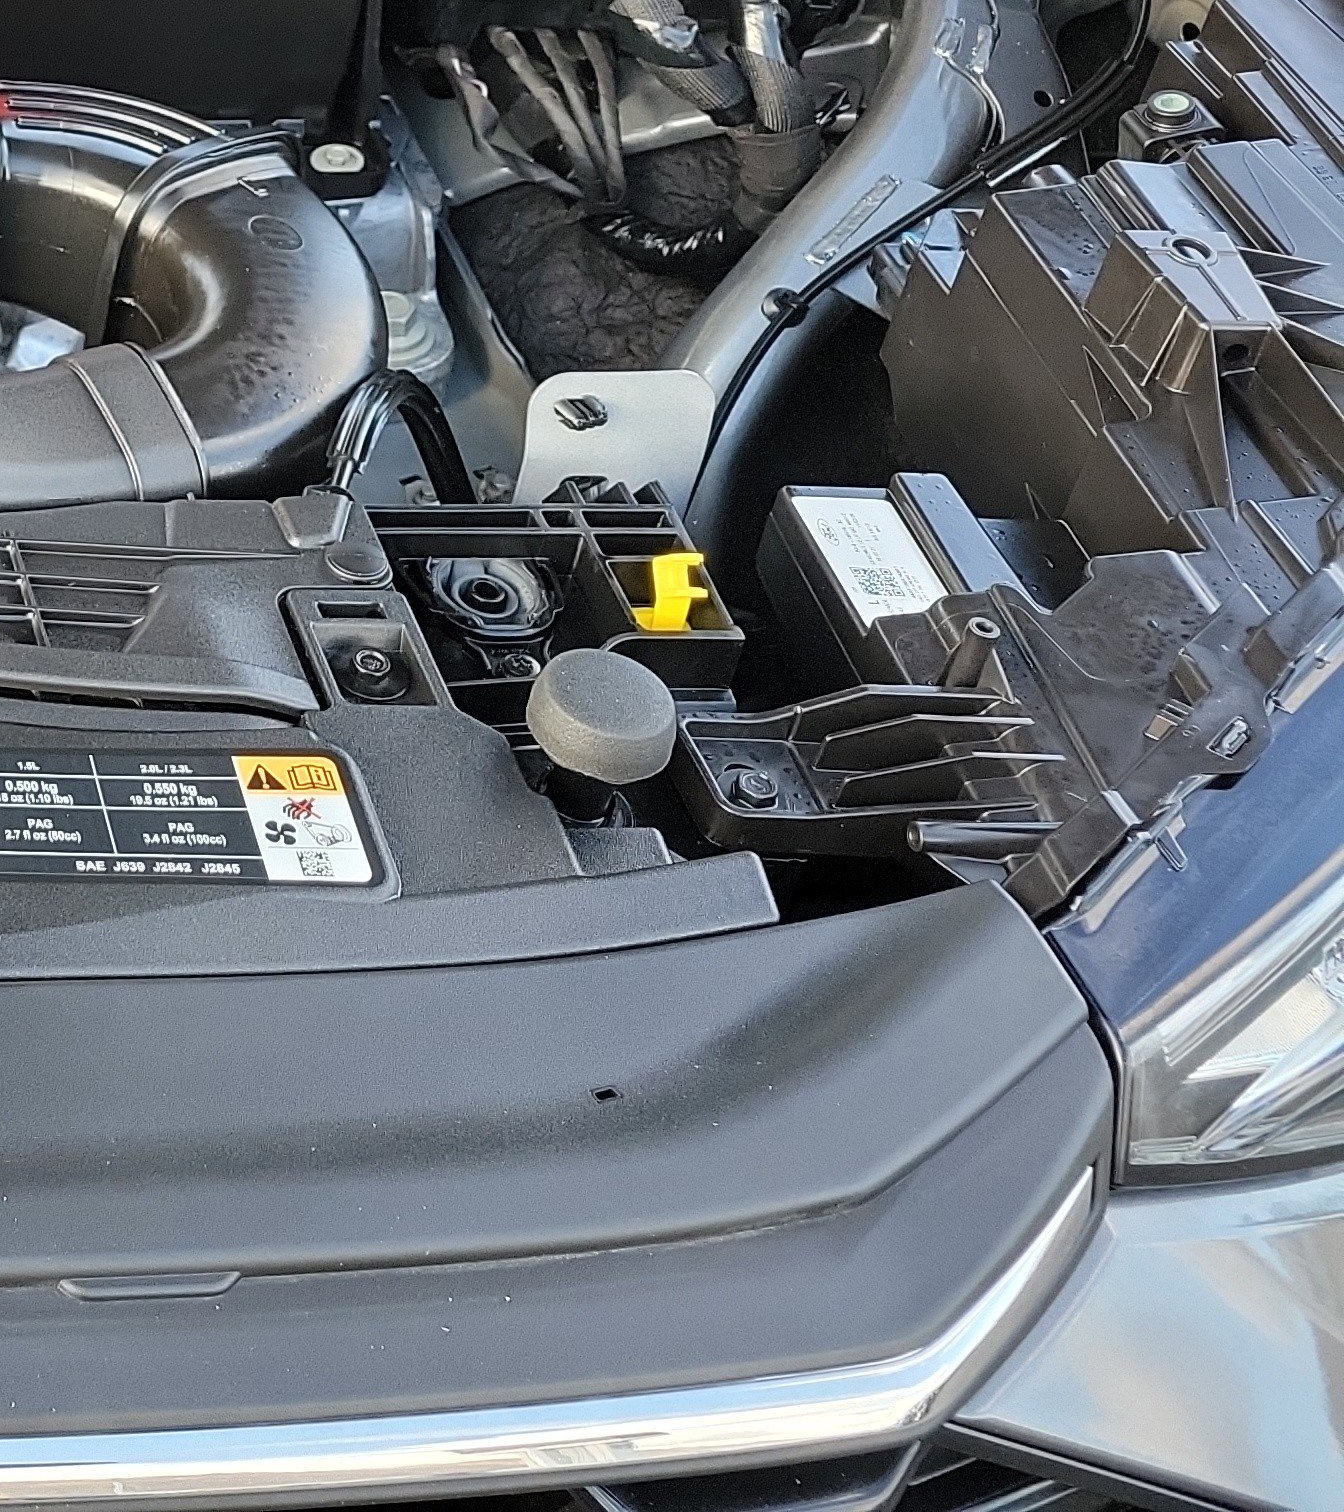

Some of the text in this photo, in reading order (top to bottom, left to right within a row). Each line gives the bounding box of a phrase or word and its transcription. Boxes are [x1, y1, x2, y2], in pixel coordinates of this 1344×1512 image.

[4, 779, 58, 795] 0.500 kg
[143, 782, 197, 797] 0.550 kg
[10, 794, 24, 803] oz
[154, 797, 168, 806] oz
[26, 818, 54, 829] PAG
[167, 822, 195, 833] PAG
[32, 832, 47, 841] oz
[142, 833, 160, 844] 3.4
[171, 835, 186, 844] oz
[186, 834, 227, 848] (100cc)
